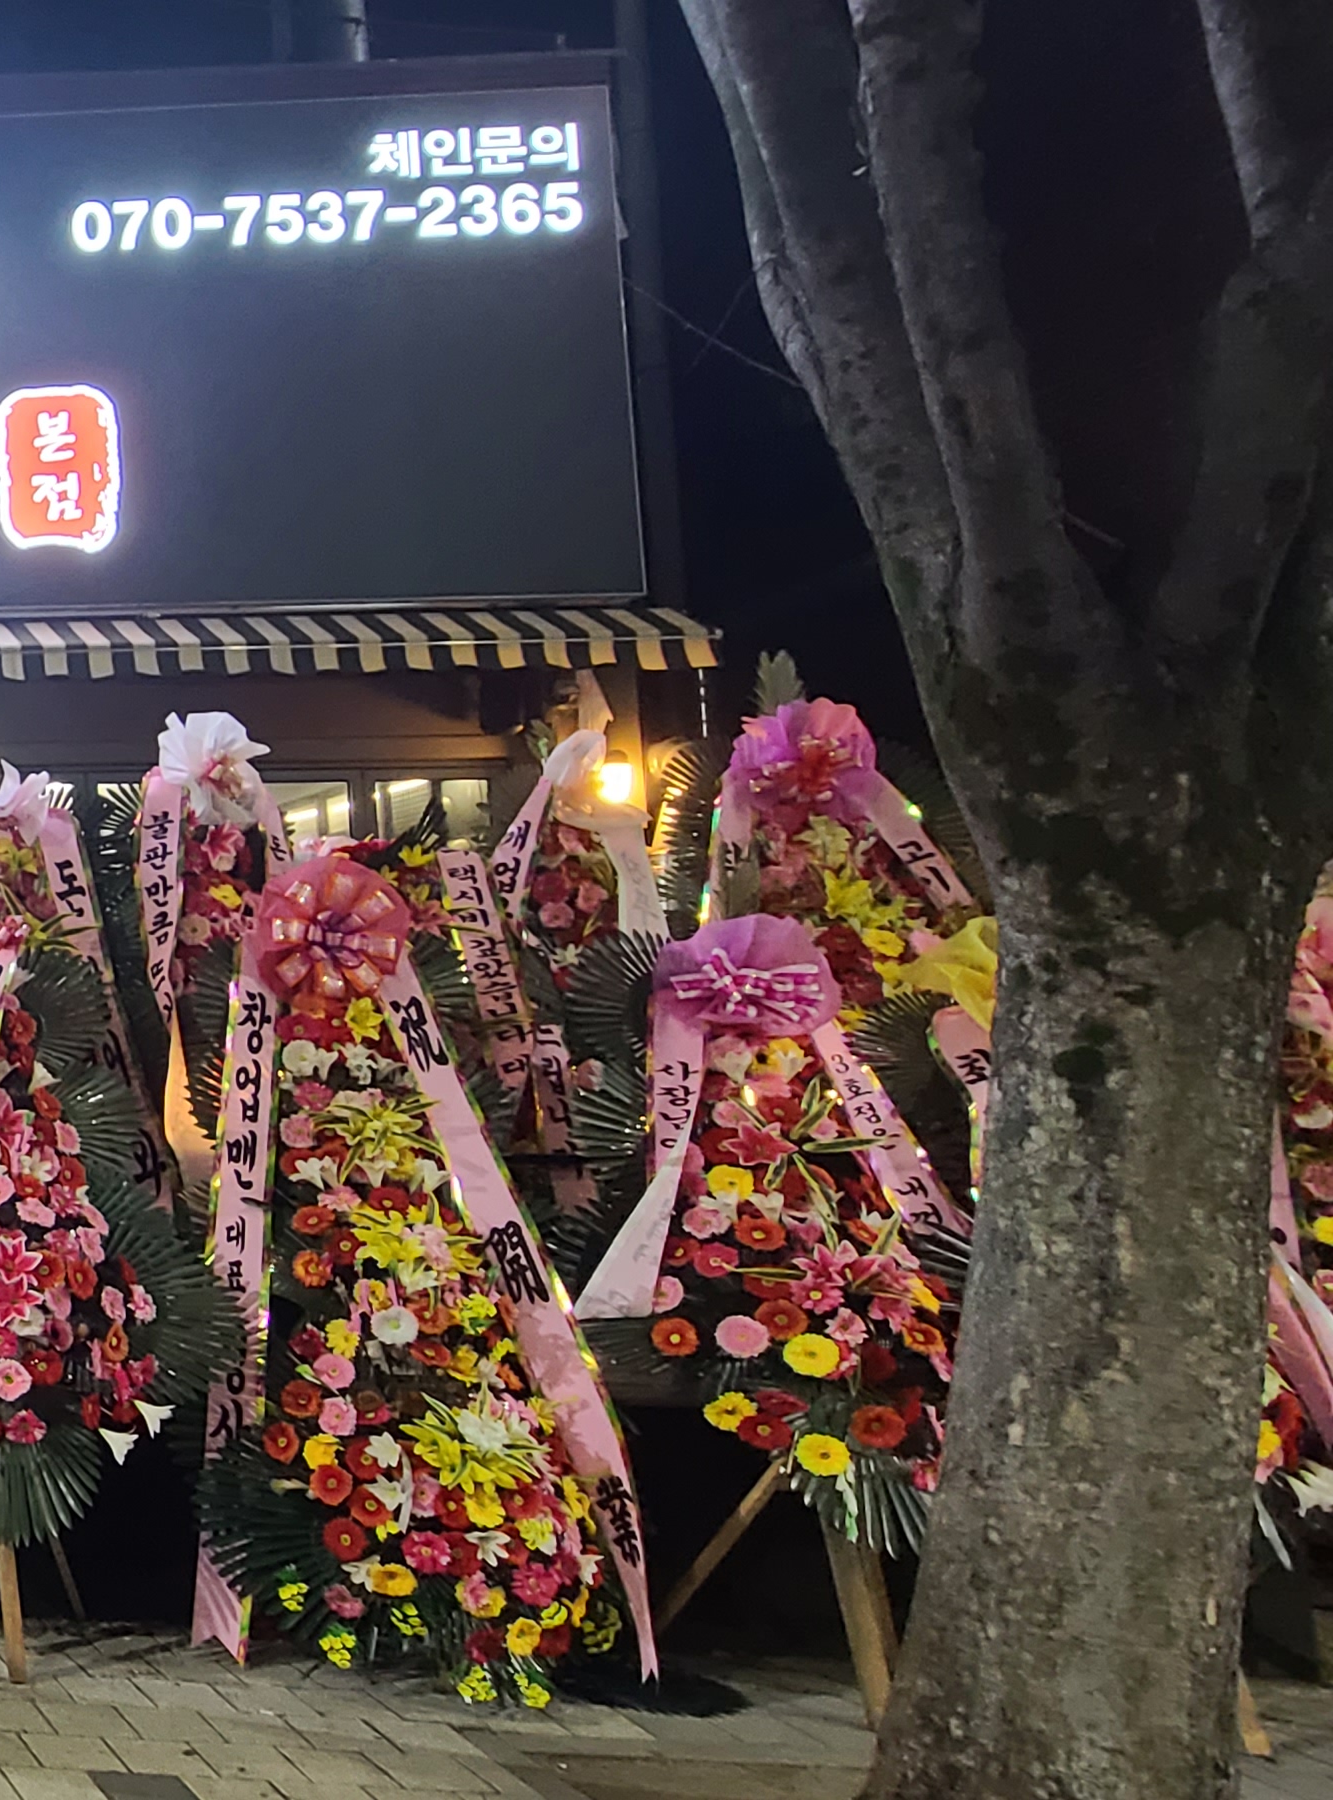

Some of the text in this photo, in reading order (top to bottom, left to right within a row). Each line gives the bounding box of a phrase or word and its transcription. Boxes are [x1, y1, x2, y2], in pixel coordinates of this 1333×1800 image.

[368, 122, 579, 178] 체인문의
[71, 181, 585, 253] 070-7537-2365
[32, 410, 77, 522] 본점
[141, 810, 175, 949] 불판만큼
[225, 991, 272, 1189] 창업맨
[536, 1025, 573, 1130] 드립니
